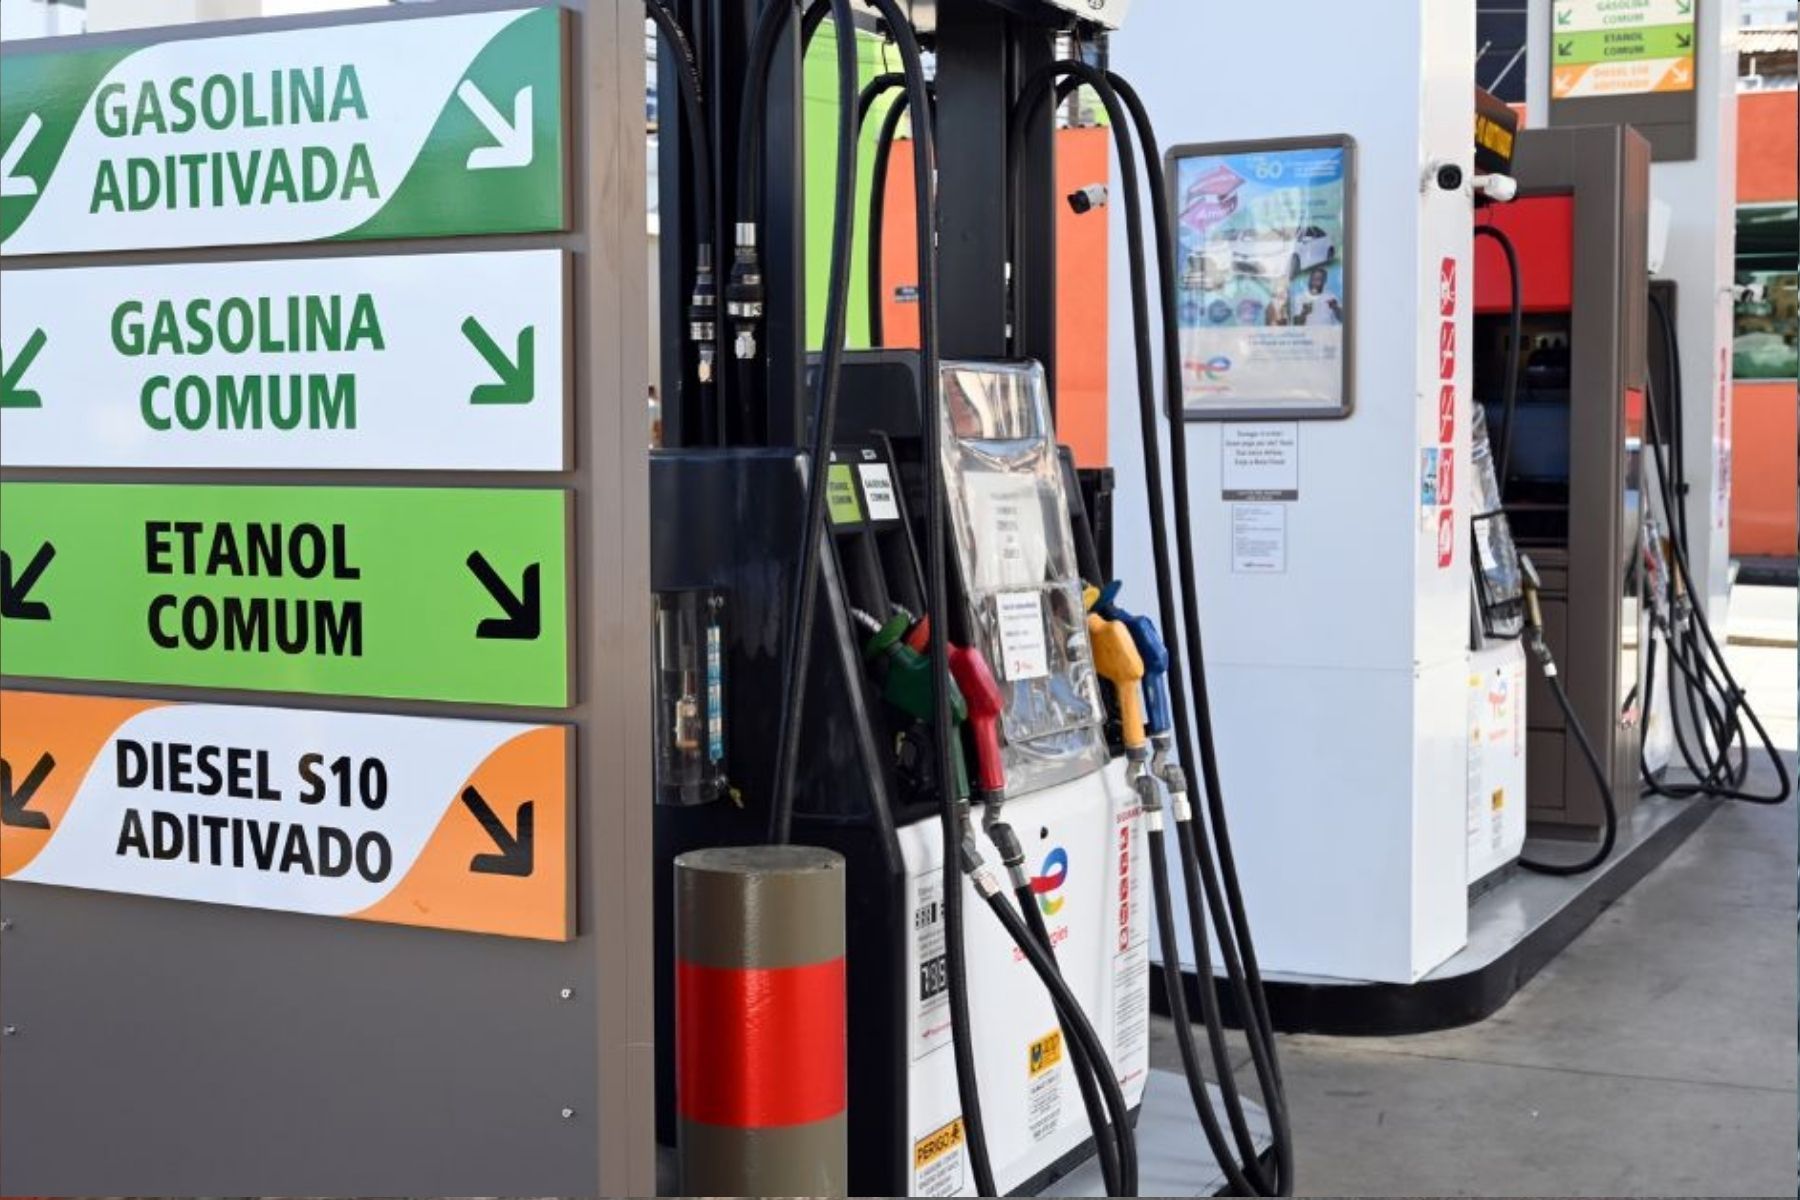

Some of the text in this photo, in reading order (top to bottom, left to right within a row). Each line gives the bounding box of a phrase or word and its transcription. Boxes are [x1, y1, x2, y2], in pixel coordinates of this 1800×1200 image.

[1603, 33, 1643, 43] ETANOL
[1603, 46, 1645, 56] COMUM
[95, 64, 369, 138] GASOLINA
[89, 142, 380, 214] ADITIVADA
[110, 293, 386, 357] GASOLINA
[139, 372, 357, 432] COMUM
[145, 521, 361, 580] ETANOL
[147, 593, 363, 657] COMUM
[116, 739, 388, 811] DIESEL S10
[116, 808, 393, 883] ADITIVADO
